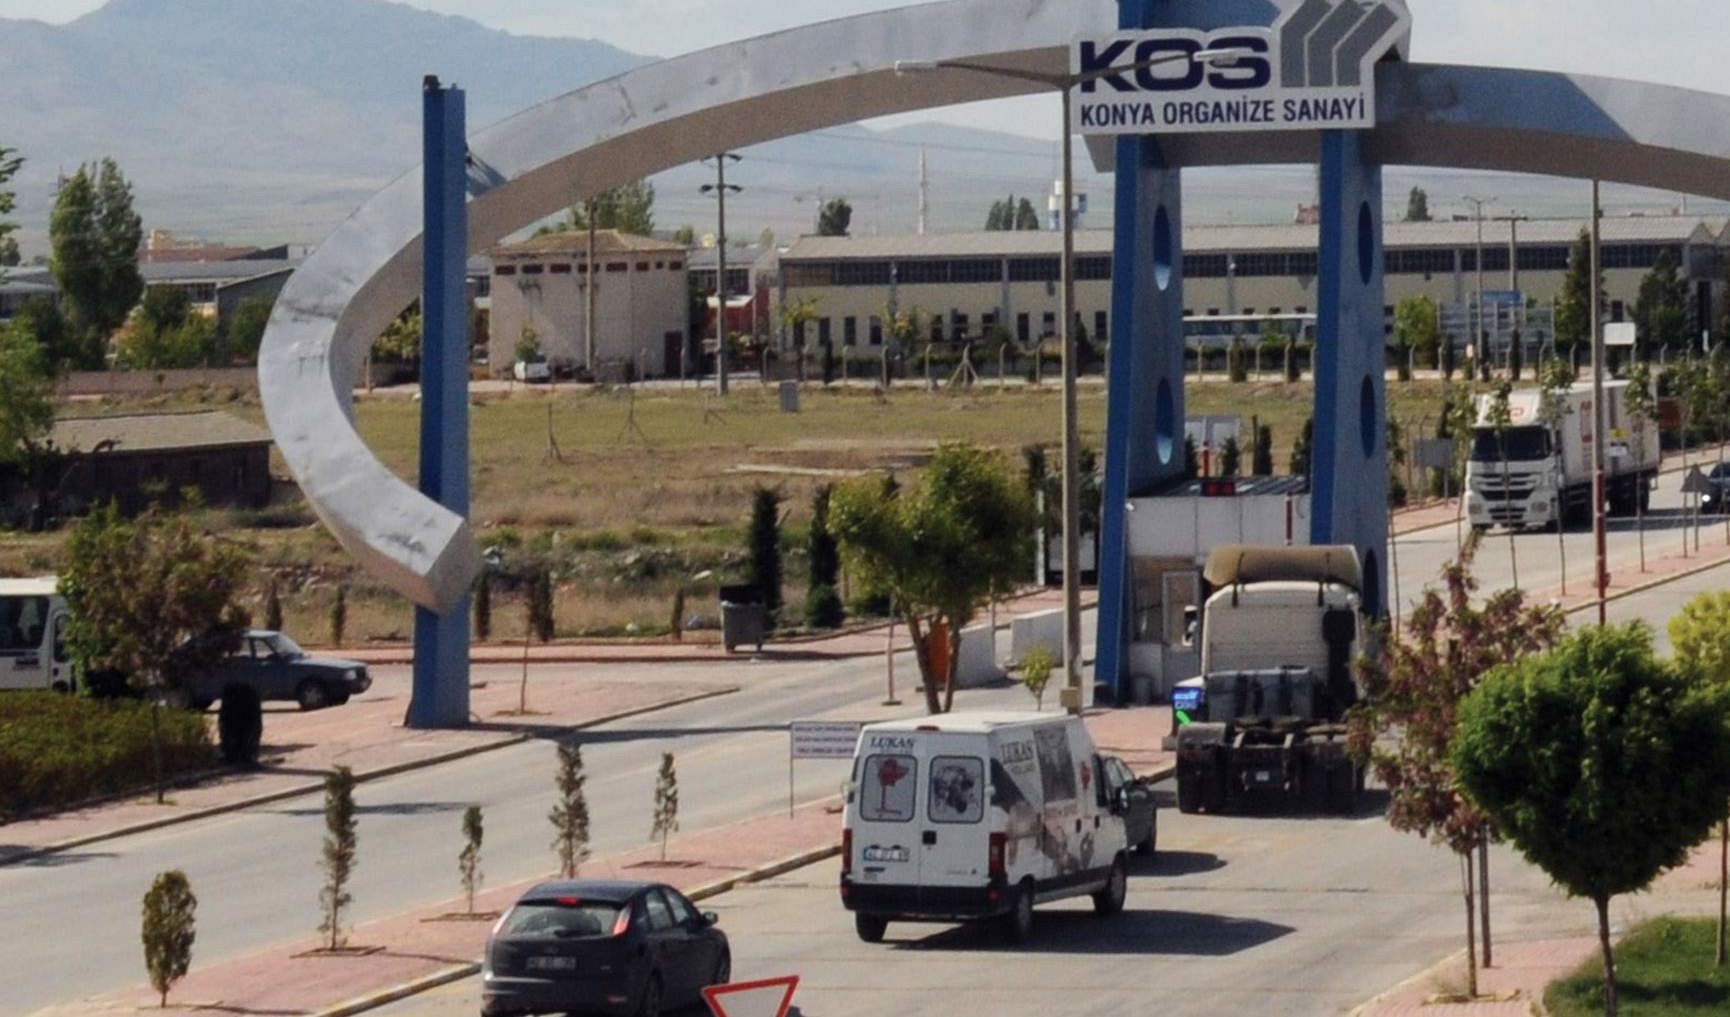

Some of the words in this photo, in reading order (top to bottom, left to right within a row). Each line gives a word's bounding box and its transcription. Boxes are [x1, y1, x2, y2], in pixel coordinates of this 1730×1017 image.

[1080, 36, 1270, 93] KOS
[1081, 102, 1155, 127] KONYA
[1163, 95, 1275, 125] ORGANİZE
[1283, 91, 1365, 122] SANAYİ
